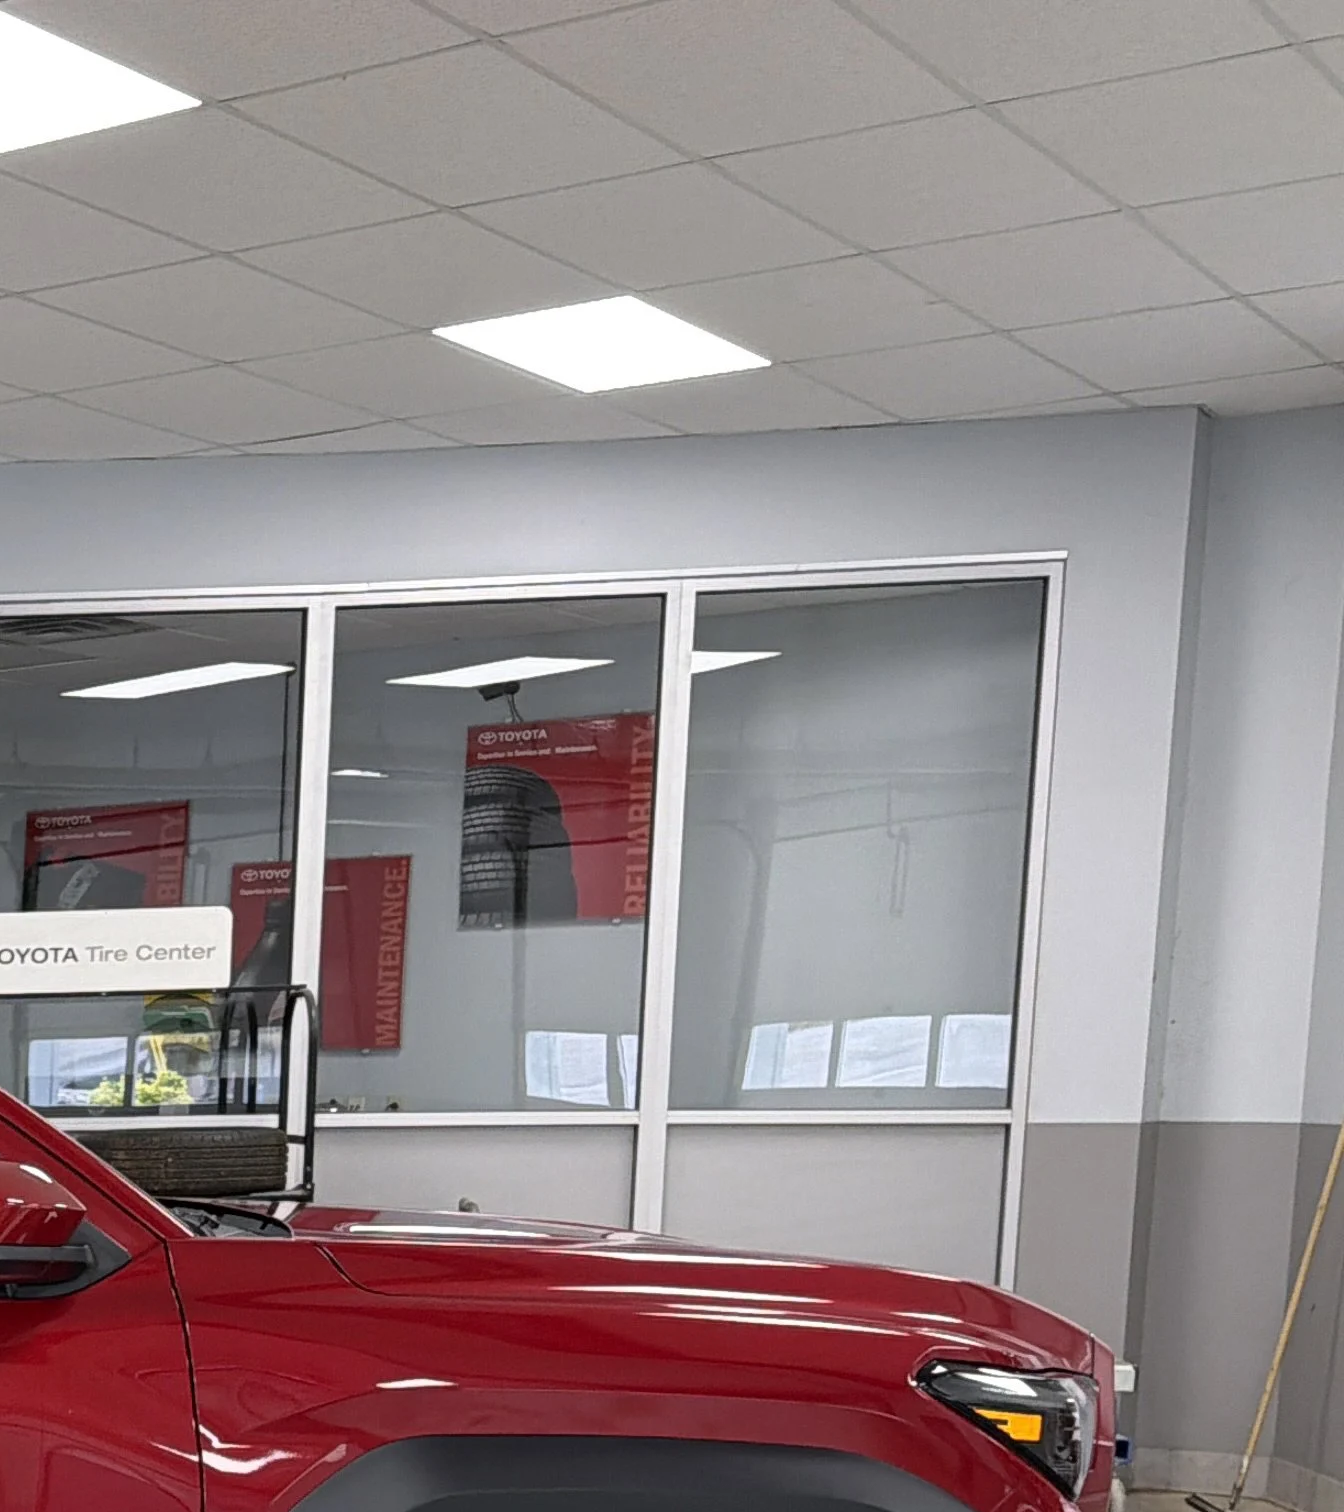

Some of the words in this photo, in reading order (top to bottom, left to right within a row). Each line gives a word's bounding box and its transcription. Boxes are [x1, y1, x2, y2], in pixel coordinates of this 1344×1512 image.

[497, 729, 548, 742] TOYOTA
[51, 815, 92, 827] TOYOTA
[258, 868, 292, 880] TOYO
[85, 945, 128, 964] Tire
[135, 943, 217, 962] Center
[375, 860, 408, 1046] MAINTENANCE.
